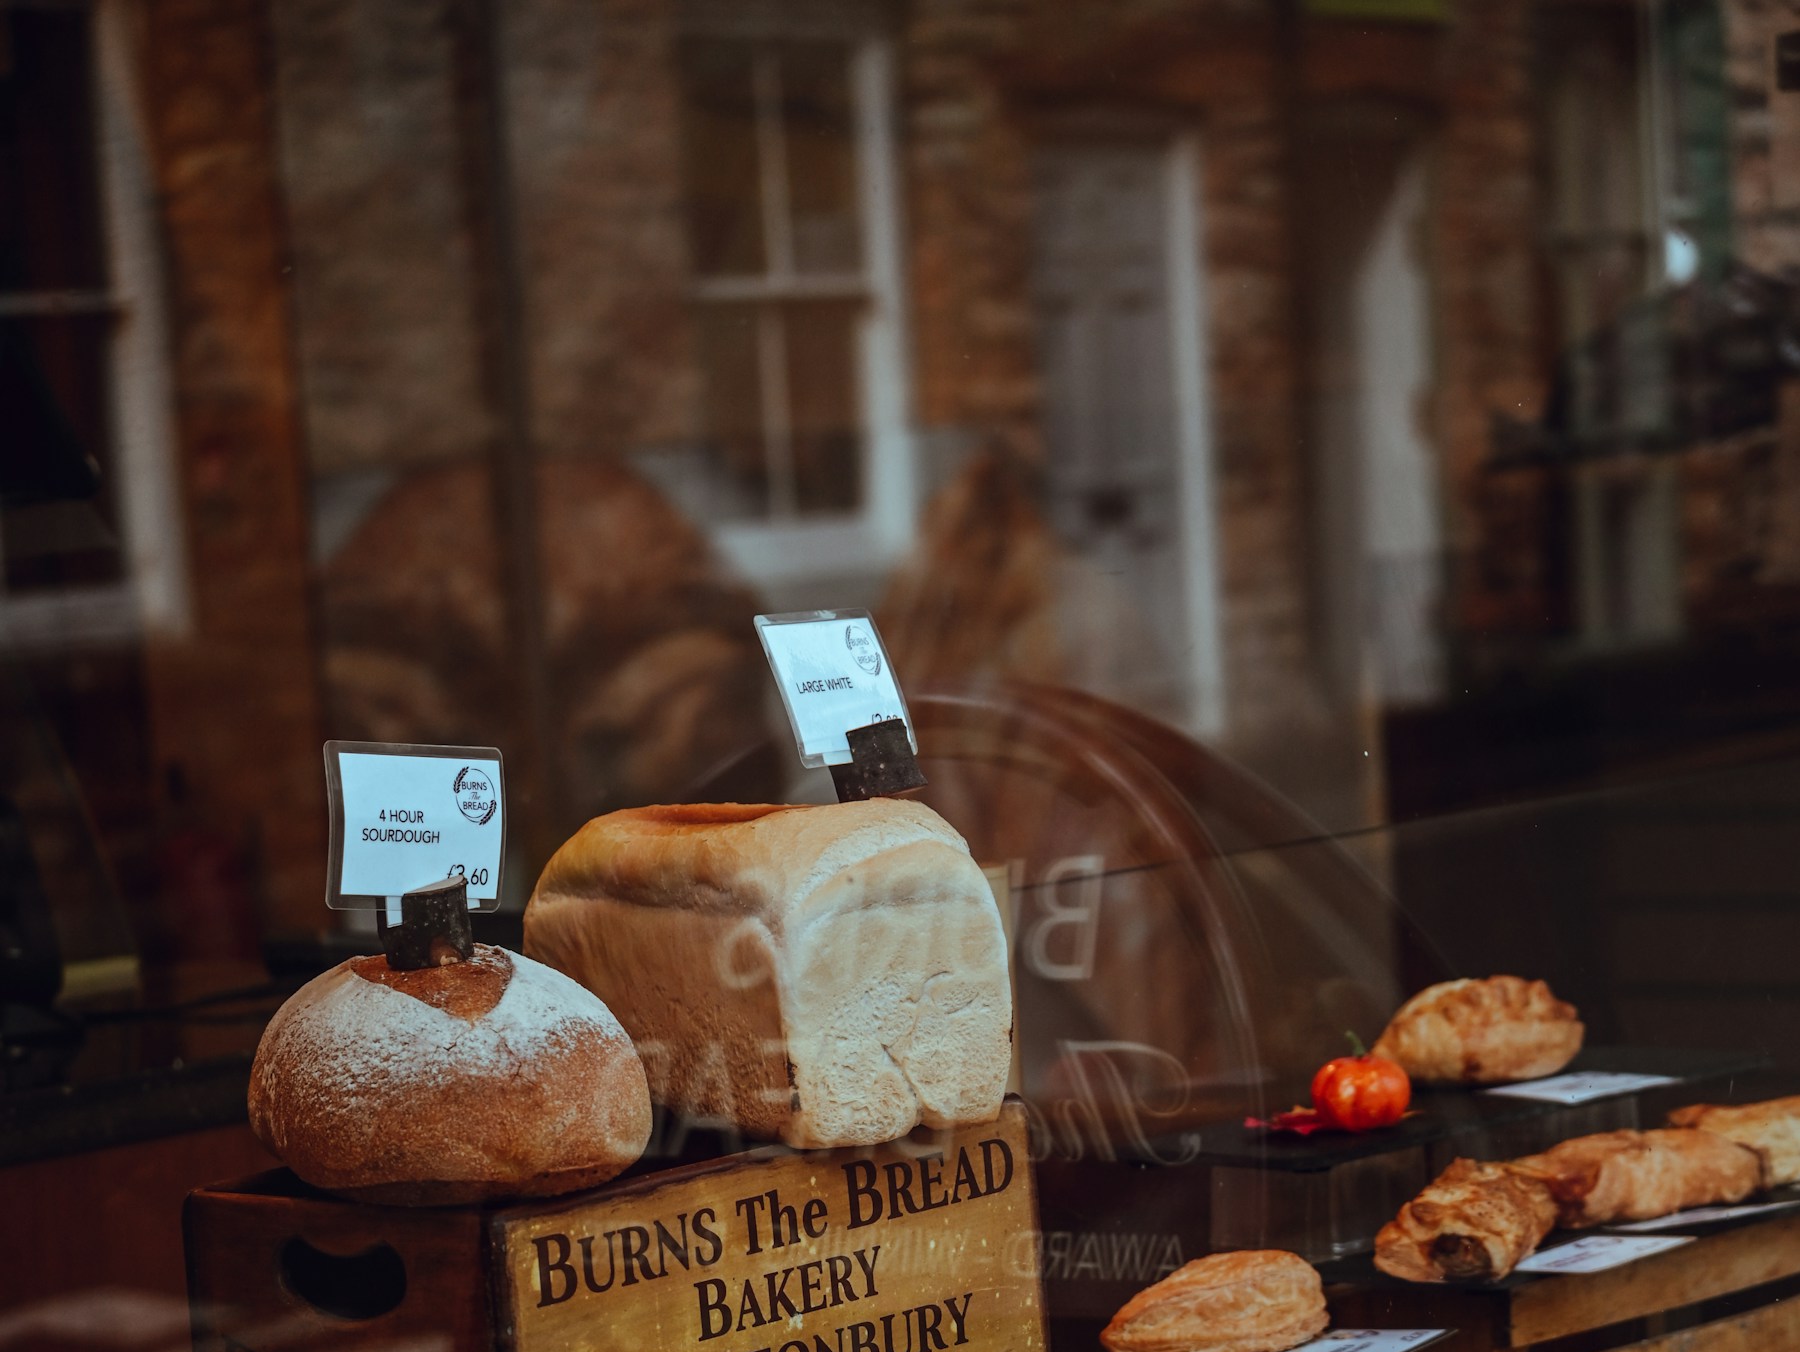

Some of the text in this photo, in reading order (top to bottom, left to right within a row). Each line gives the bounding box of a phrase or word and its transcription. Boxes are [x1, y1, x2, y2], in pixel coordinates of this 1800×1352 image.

[850, 637, 870, 647] BURNS
[857, 655, 877, 664] BREAD
[796, 677, 854, 694] LARGE WHITE
[461, 781, 488, 791] BURNS
[468, 791, 481, 800] The
[462, 801, 489, 811] BREAD
[379, 809, 424, 824] 4 HOUR
[362, 828, 440, 844] SOURDOUGH
[531, 1206, 724, 1309] BURNS
[735, 1189, 829, 1256] The
[841, 1137, 1014, 1231] BREAD
[693, 1245, 881, 1342] BAKERY
